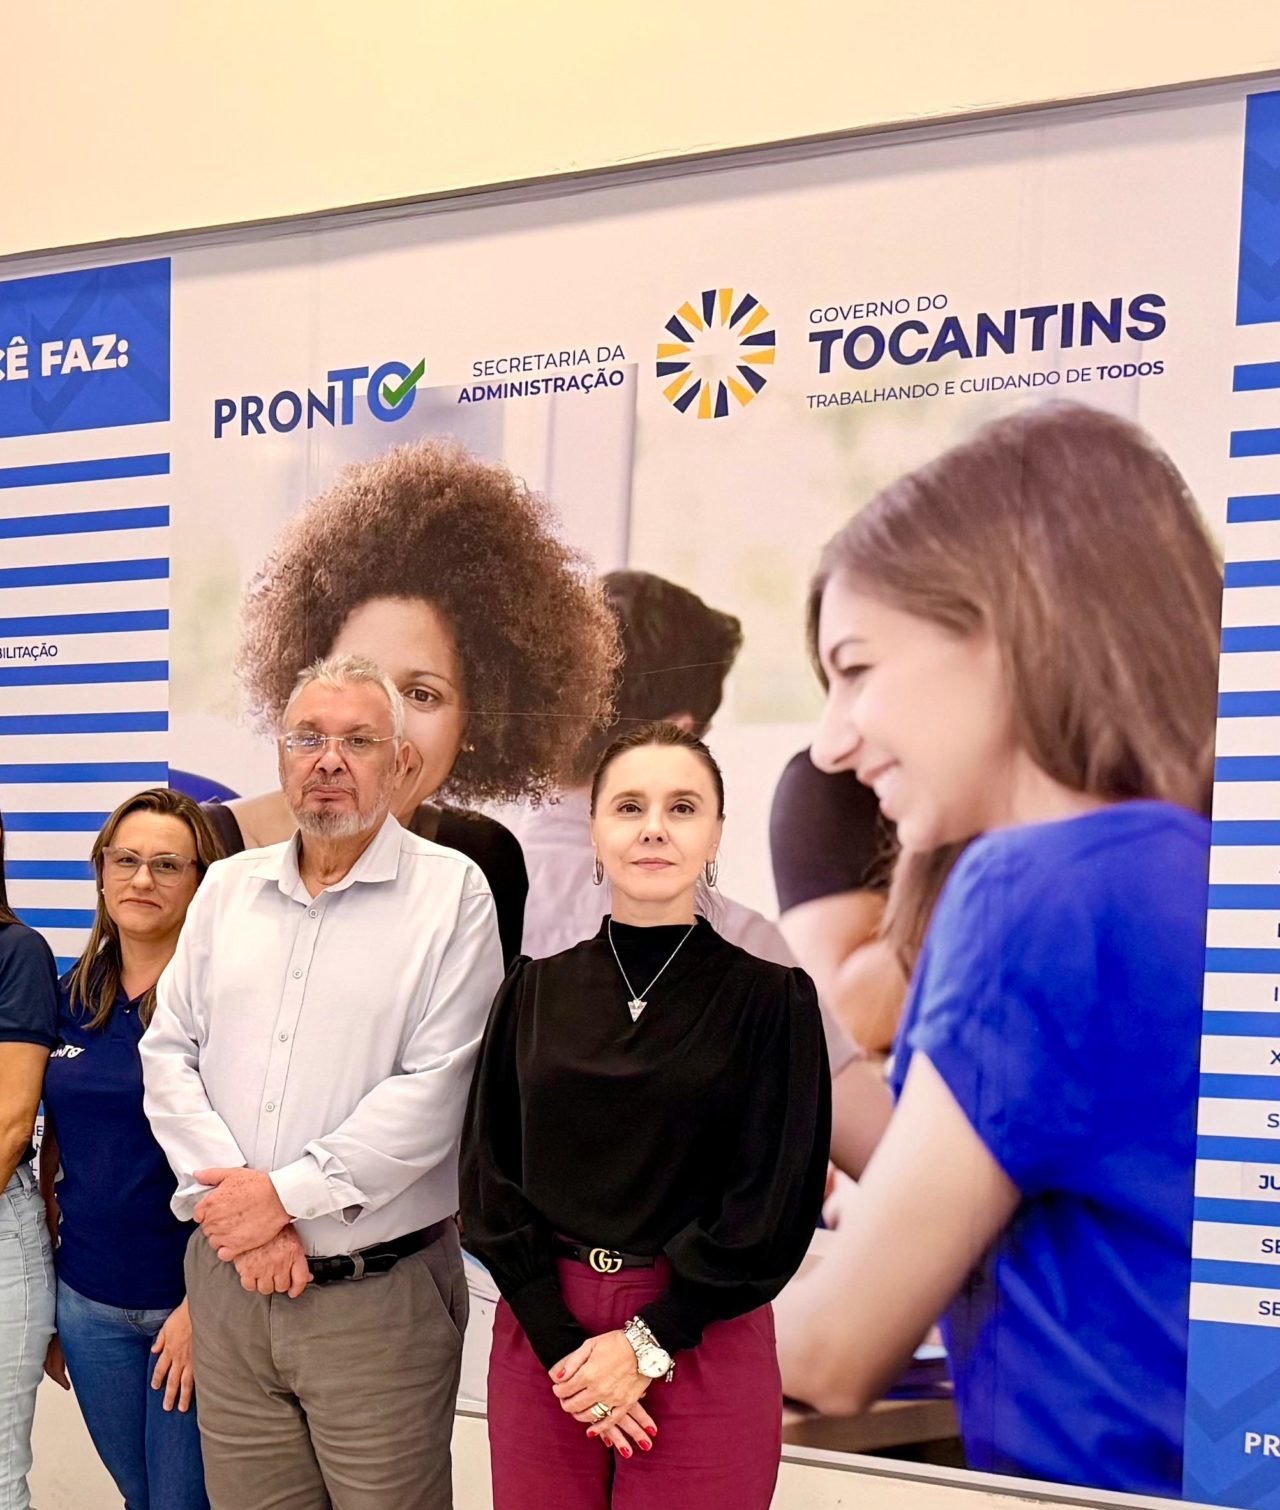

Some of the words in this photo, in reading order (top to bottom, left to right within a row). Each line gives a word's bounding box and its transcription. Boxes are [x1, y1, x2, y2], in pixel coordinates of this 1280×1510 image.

[809, 299, 910, 324] GOVERNO
[917, 294, 948, 310] DO
[41, 333, 129, 377] FAZ:
[809, 293, 1166, 374] TOCANTINS
[473, 349, 590, 377] SECRETARIA
[597, 345, 625, 363] DA
[214, 361, 418, 438] PRONTO
[458, 369, 624, 403] ADMINISTRAÇÃO
[807, 381, 939, 409] TRABALHANDO
[945, 381, 955, 395] E
[960, 370, 1060, 394] CUIDANDO
[1066, 367, 1091, 382] DE
[1097, 360, 1164, 381] TODOS
